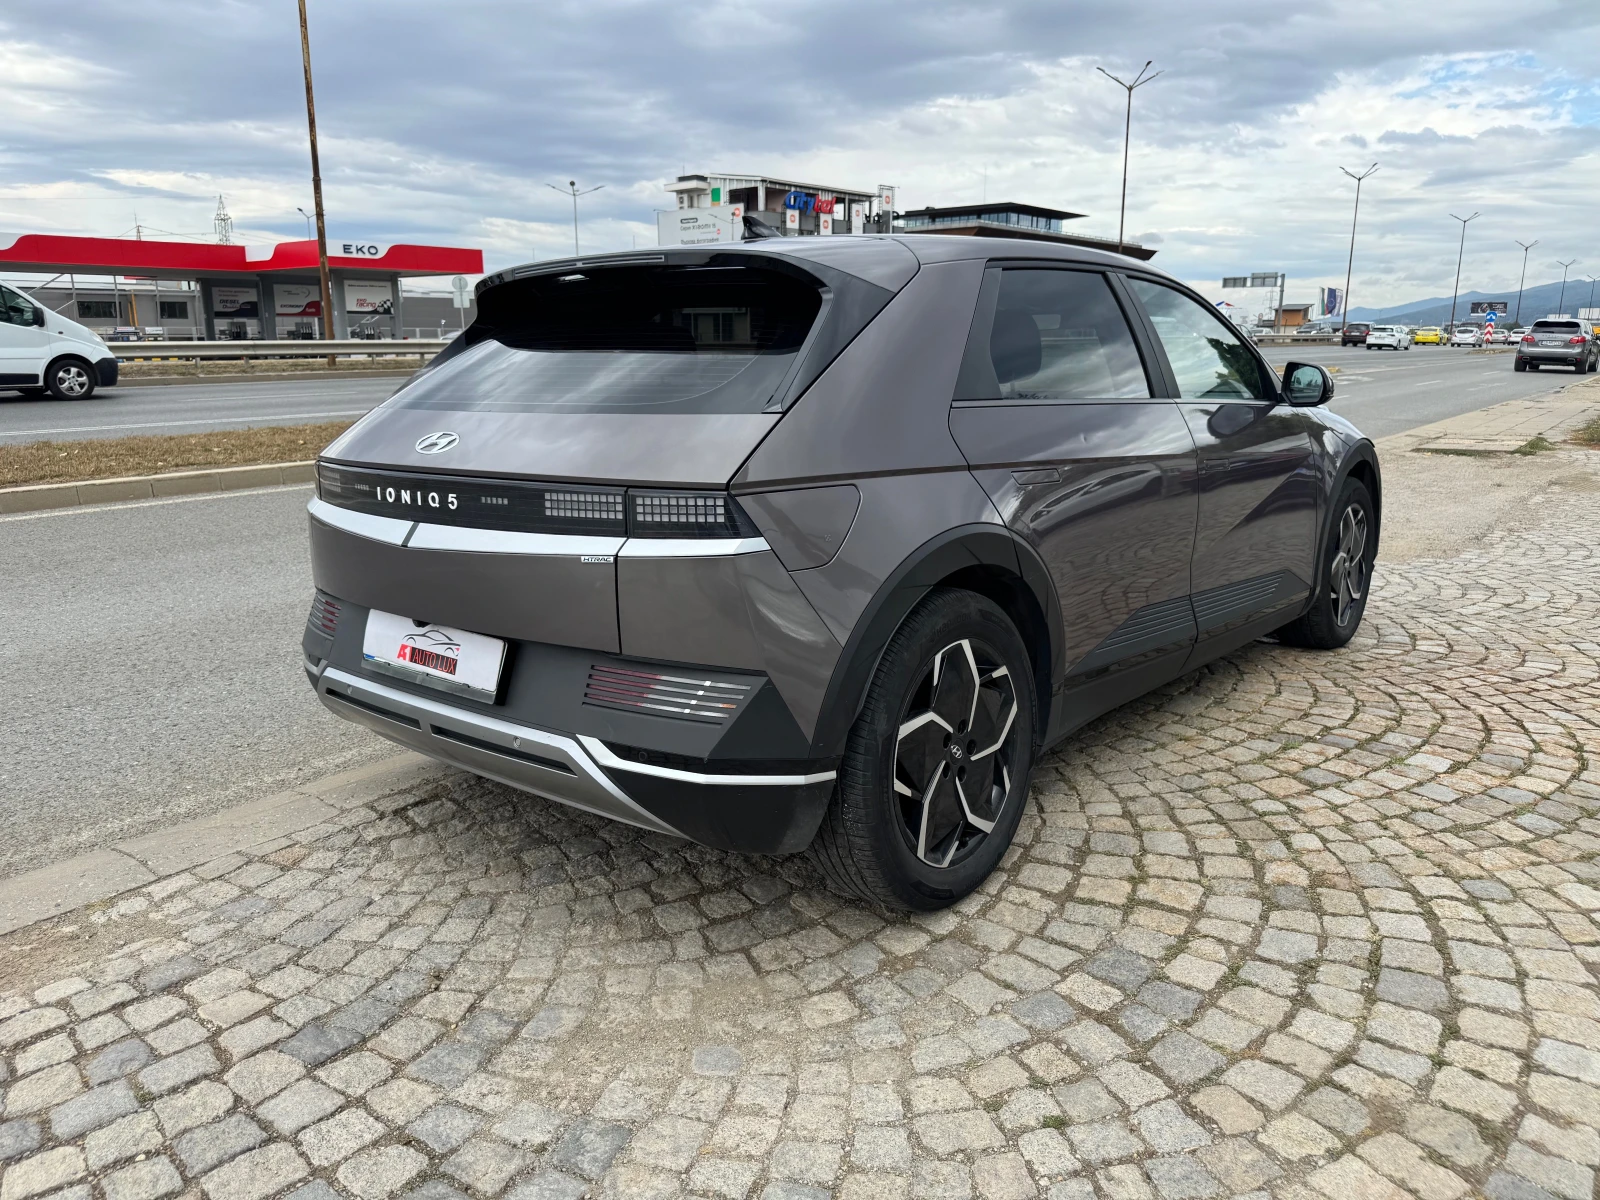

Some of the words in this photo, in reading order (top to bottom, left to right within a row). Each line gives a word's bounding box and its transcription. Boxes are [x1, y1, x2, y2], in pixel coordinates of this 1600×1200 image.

[343, 244, 378, 255] EKO
[376, 486, 440, 508] IONIQ
[447, 493, 458, 510] 5
[397, 644, 412, 662] A1
[412, 649, 436, 668] AUTO
[437, 655, 457, 675] LUX
